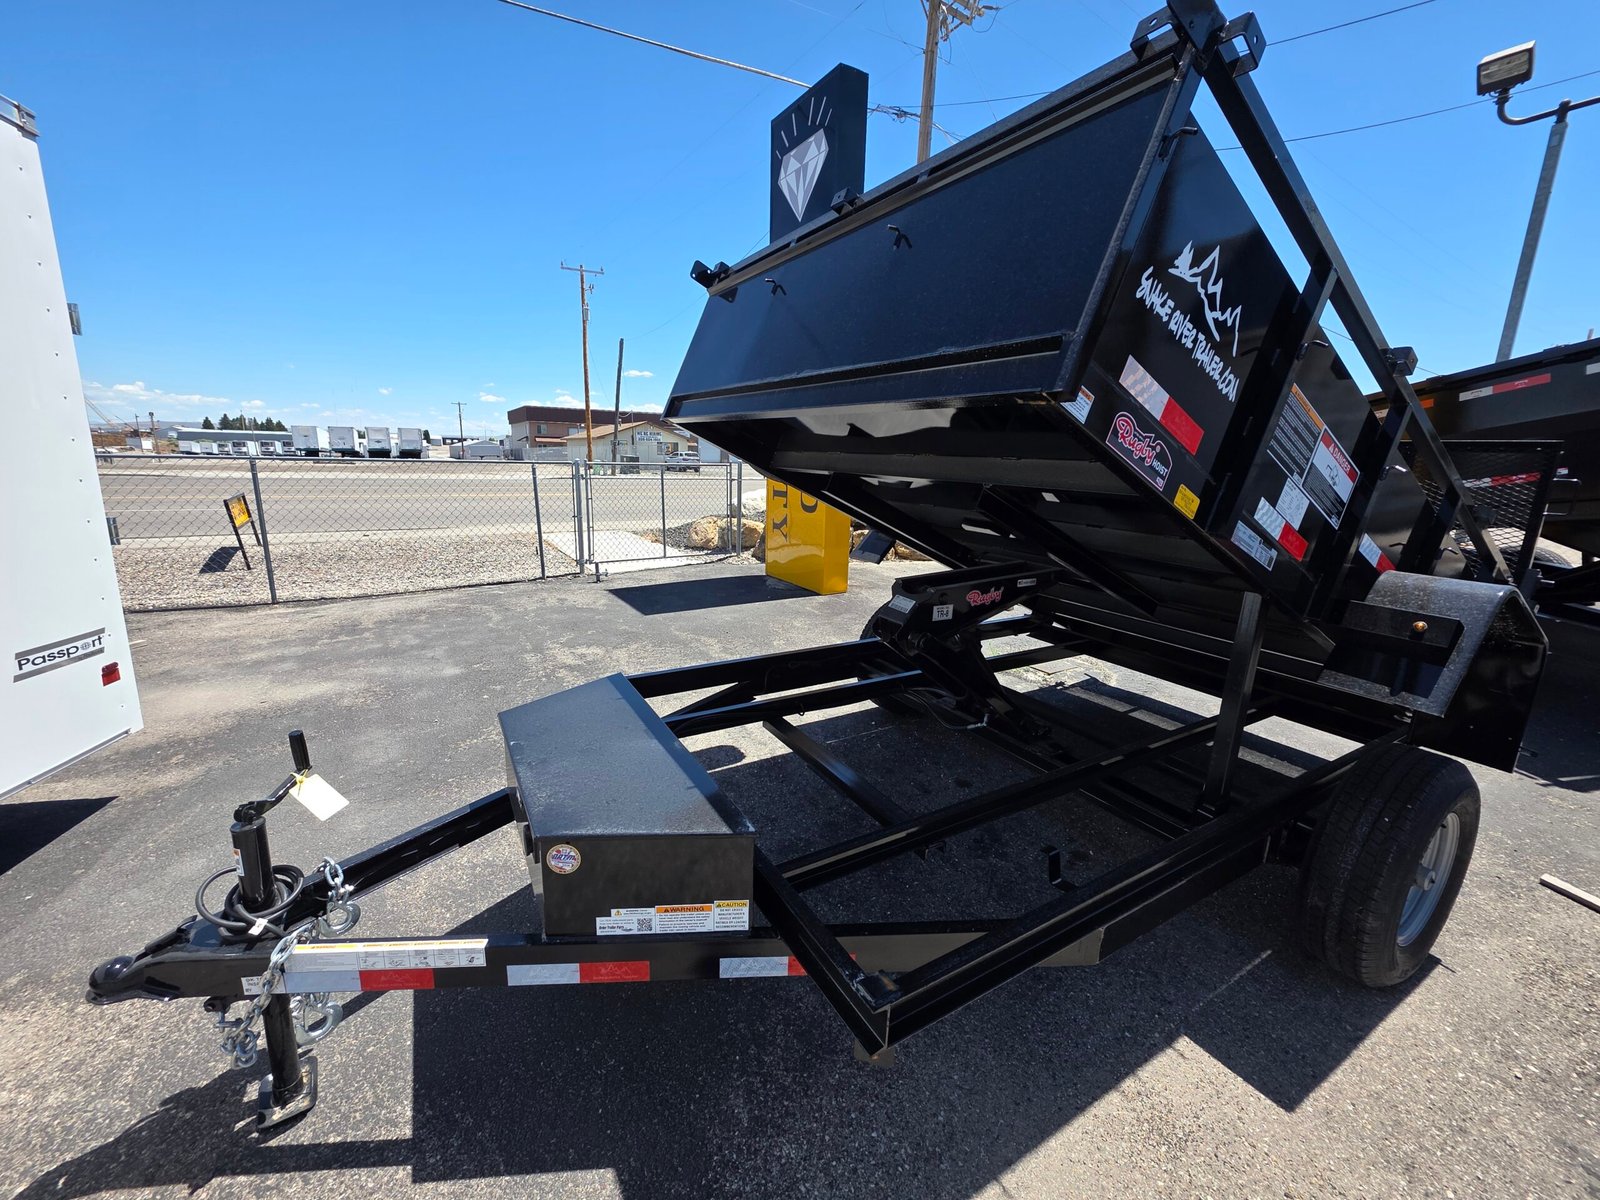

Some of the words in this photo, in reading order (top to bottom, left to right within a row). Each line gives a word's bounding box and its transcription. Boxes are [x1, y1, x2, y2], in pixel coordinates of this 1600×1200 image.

[1136, 266, 1175, 322] SNAKE
[1168, 310, 1197, 349] RIVER
[1192, 331, 1240, 402] TRAILER.COM
[1116, 416, 1157, 466] Rugby
[1152, 459, 1168, 477] HOIST
[1333, 449, 1352, 475] DANGER
[966, 586, 1005, 608] Rugby
